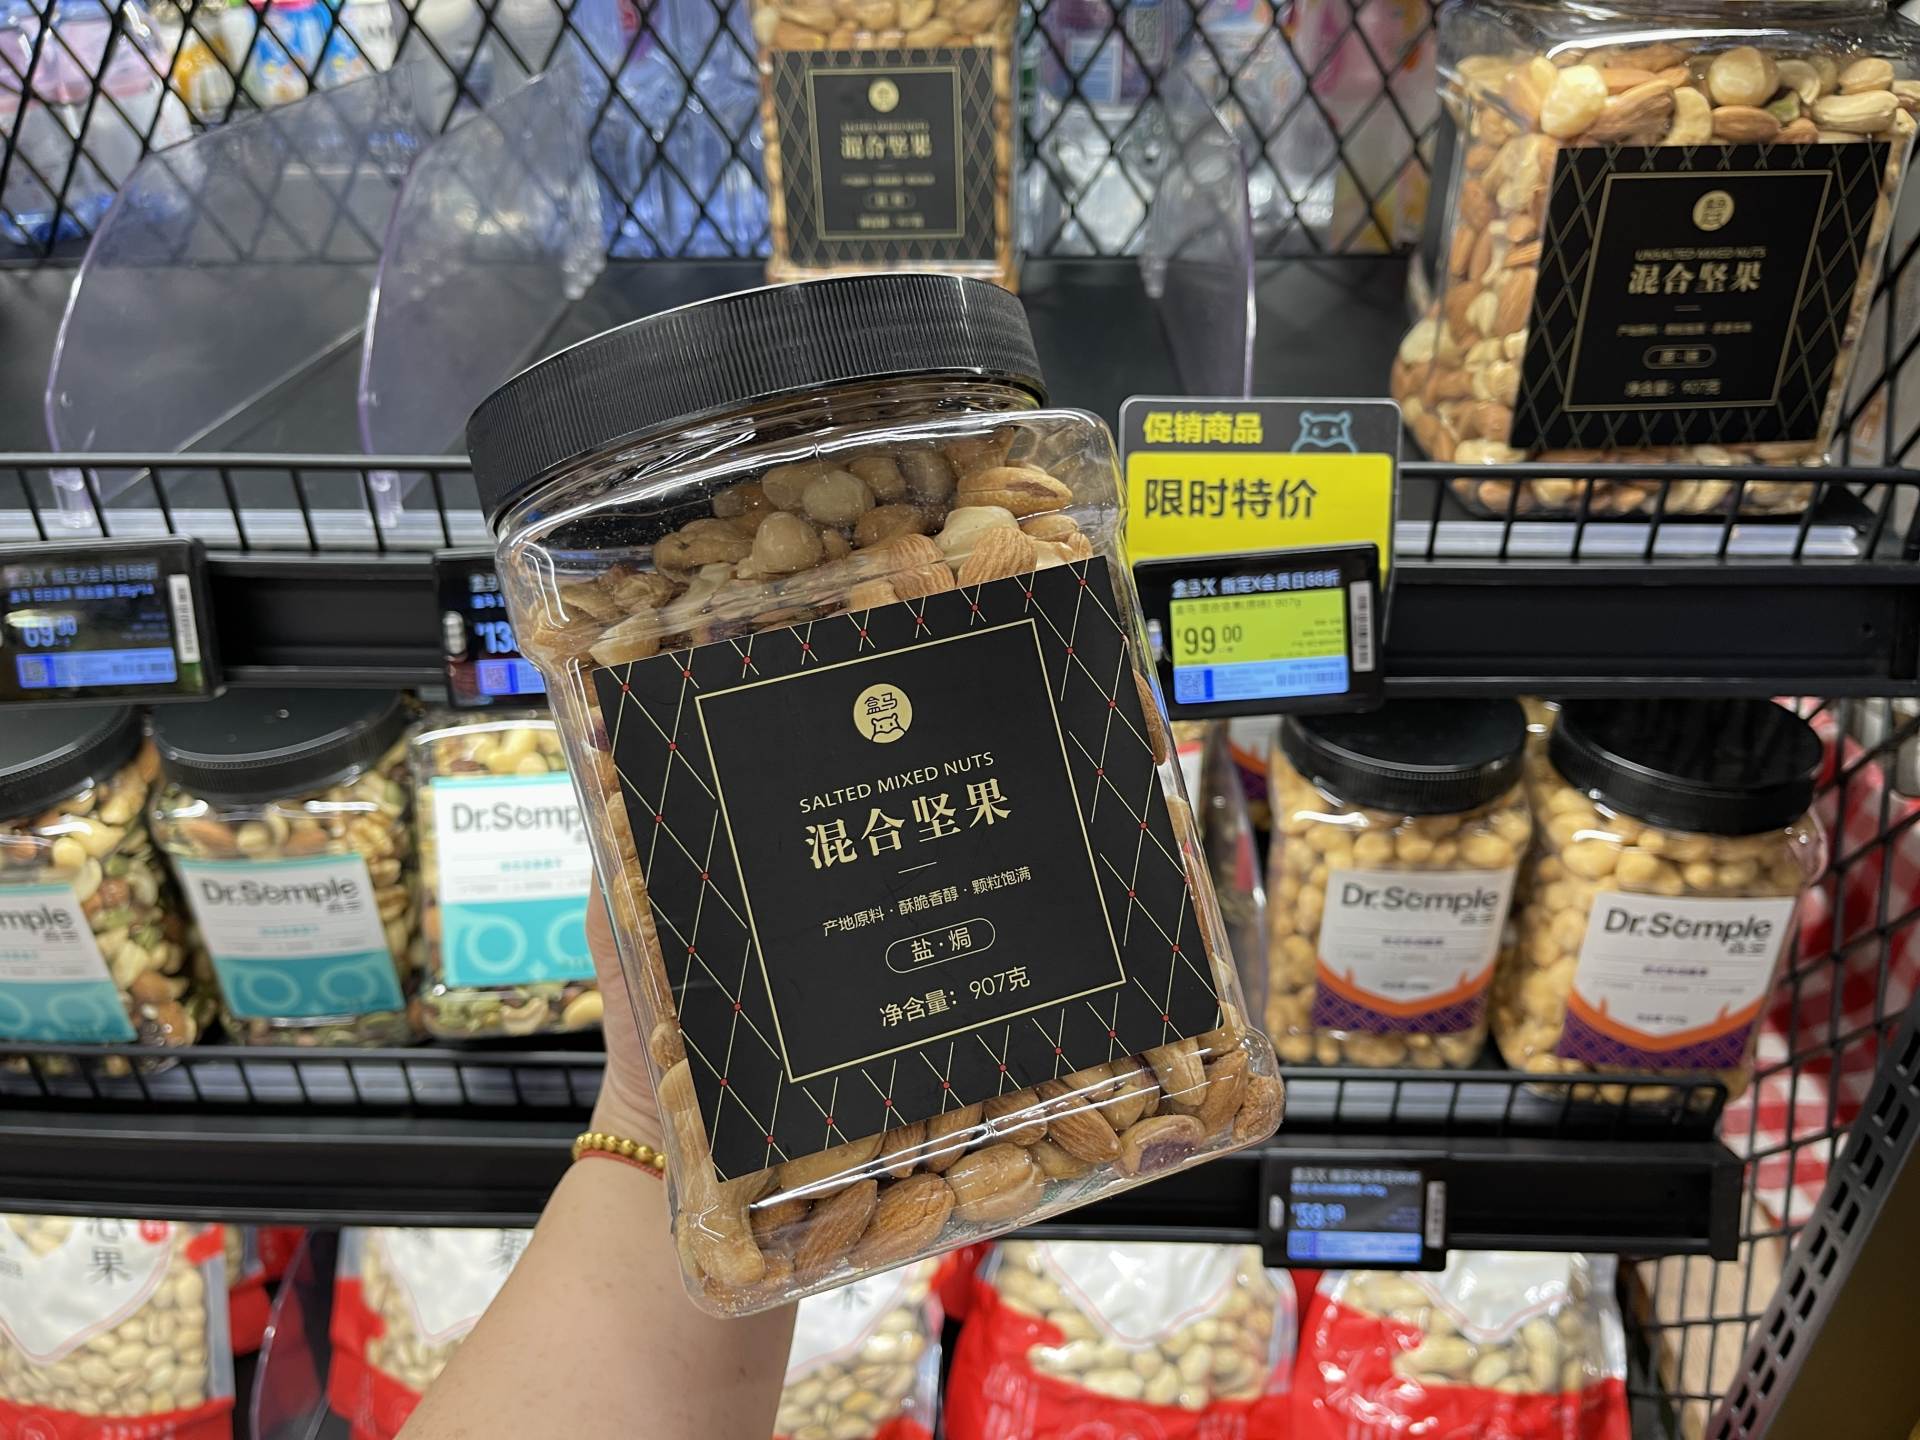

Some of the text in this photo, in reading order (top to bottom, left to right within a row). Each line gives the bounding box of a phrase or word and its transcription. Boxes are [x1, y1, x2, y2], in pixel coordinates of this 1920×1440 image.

[1628, 261, 1761, 295] 混合坚果
[1143, 411, 1263, 444] 促销商品
[1144, 478, 1317, 519] 限时特价
[864, 692, 898, 716] 盒马
[799, 751, 994, 814] SALTED MIXED NUTS
[804, 778, 1012, 869] 混合坚果
